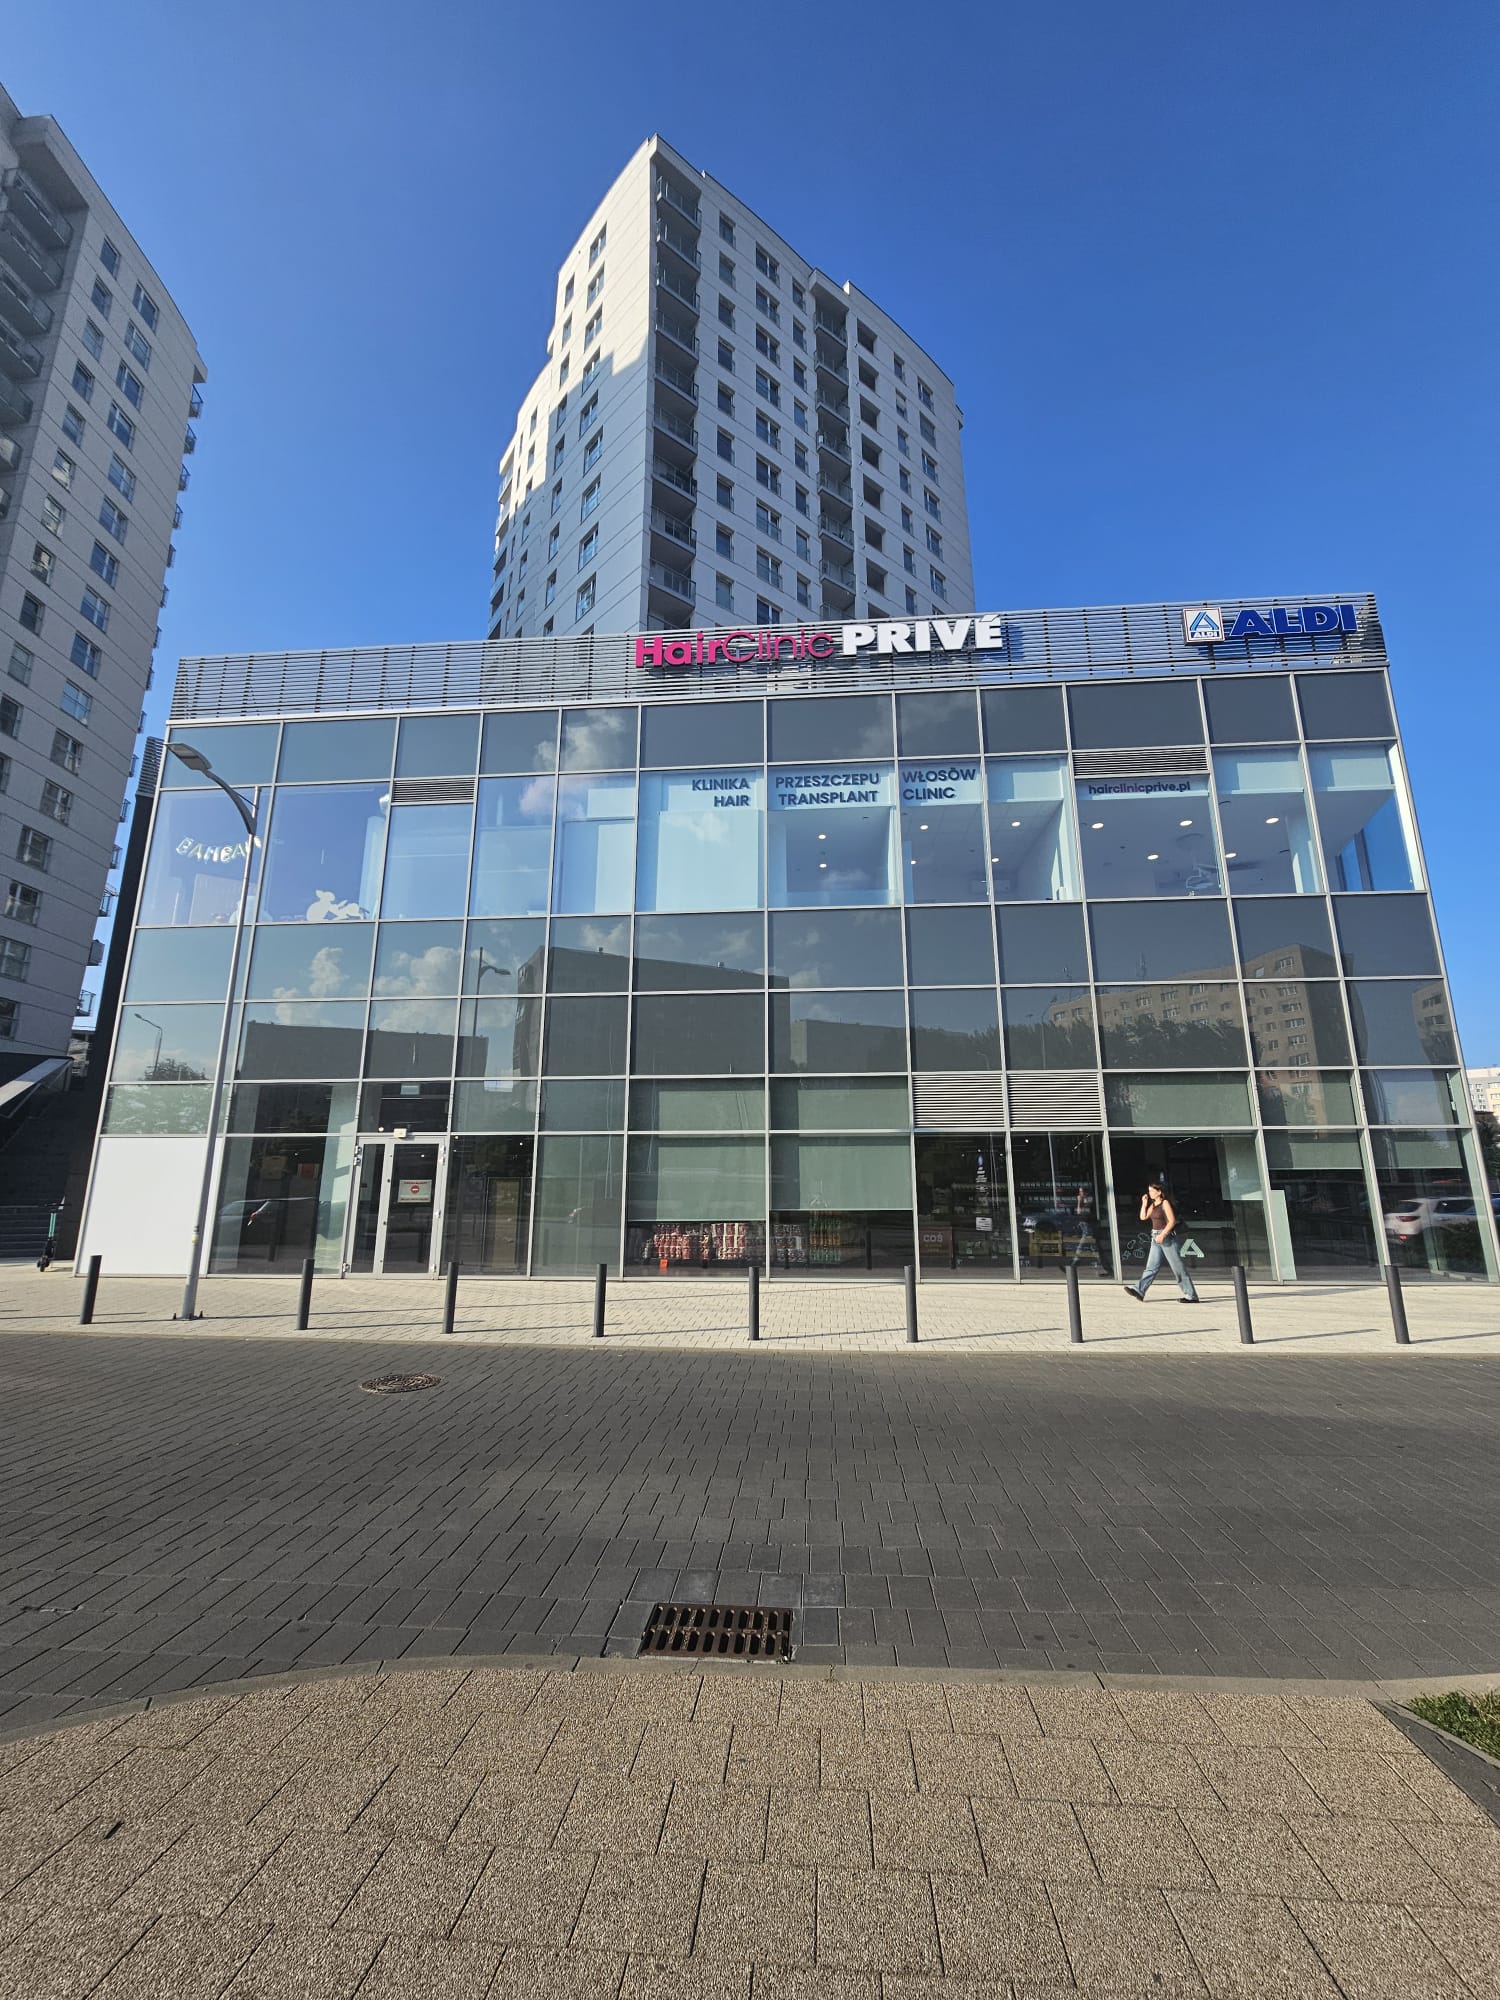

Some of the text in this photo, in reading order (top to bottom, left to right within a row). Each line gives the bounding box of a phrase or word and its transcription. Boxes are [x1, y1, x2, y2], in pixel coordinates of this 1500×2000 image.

[1229, 604, 1358, 637] ALDI
[635, 614, 1003, 668] HairClinic PRIVÉ
[1192, 631, 1218, 639] ALDI
[691, 767, 977, 791] KLINIKA PRZESZCZEPU WŁOSÓW
[1088, 781, 1191, 795] hairclinicprive.pl
[713, 786, 956, 807] HAIR TRANSPLANT CLINIC
